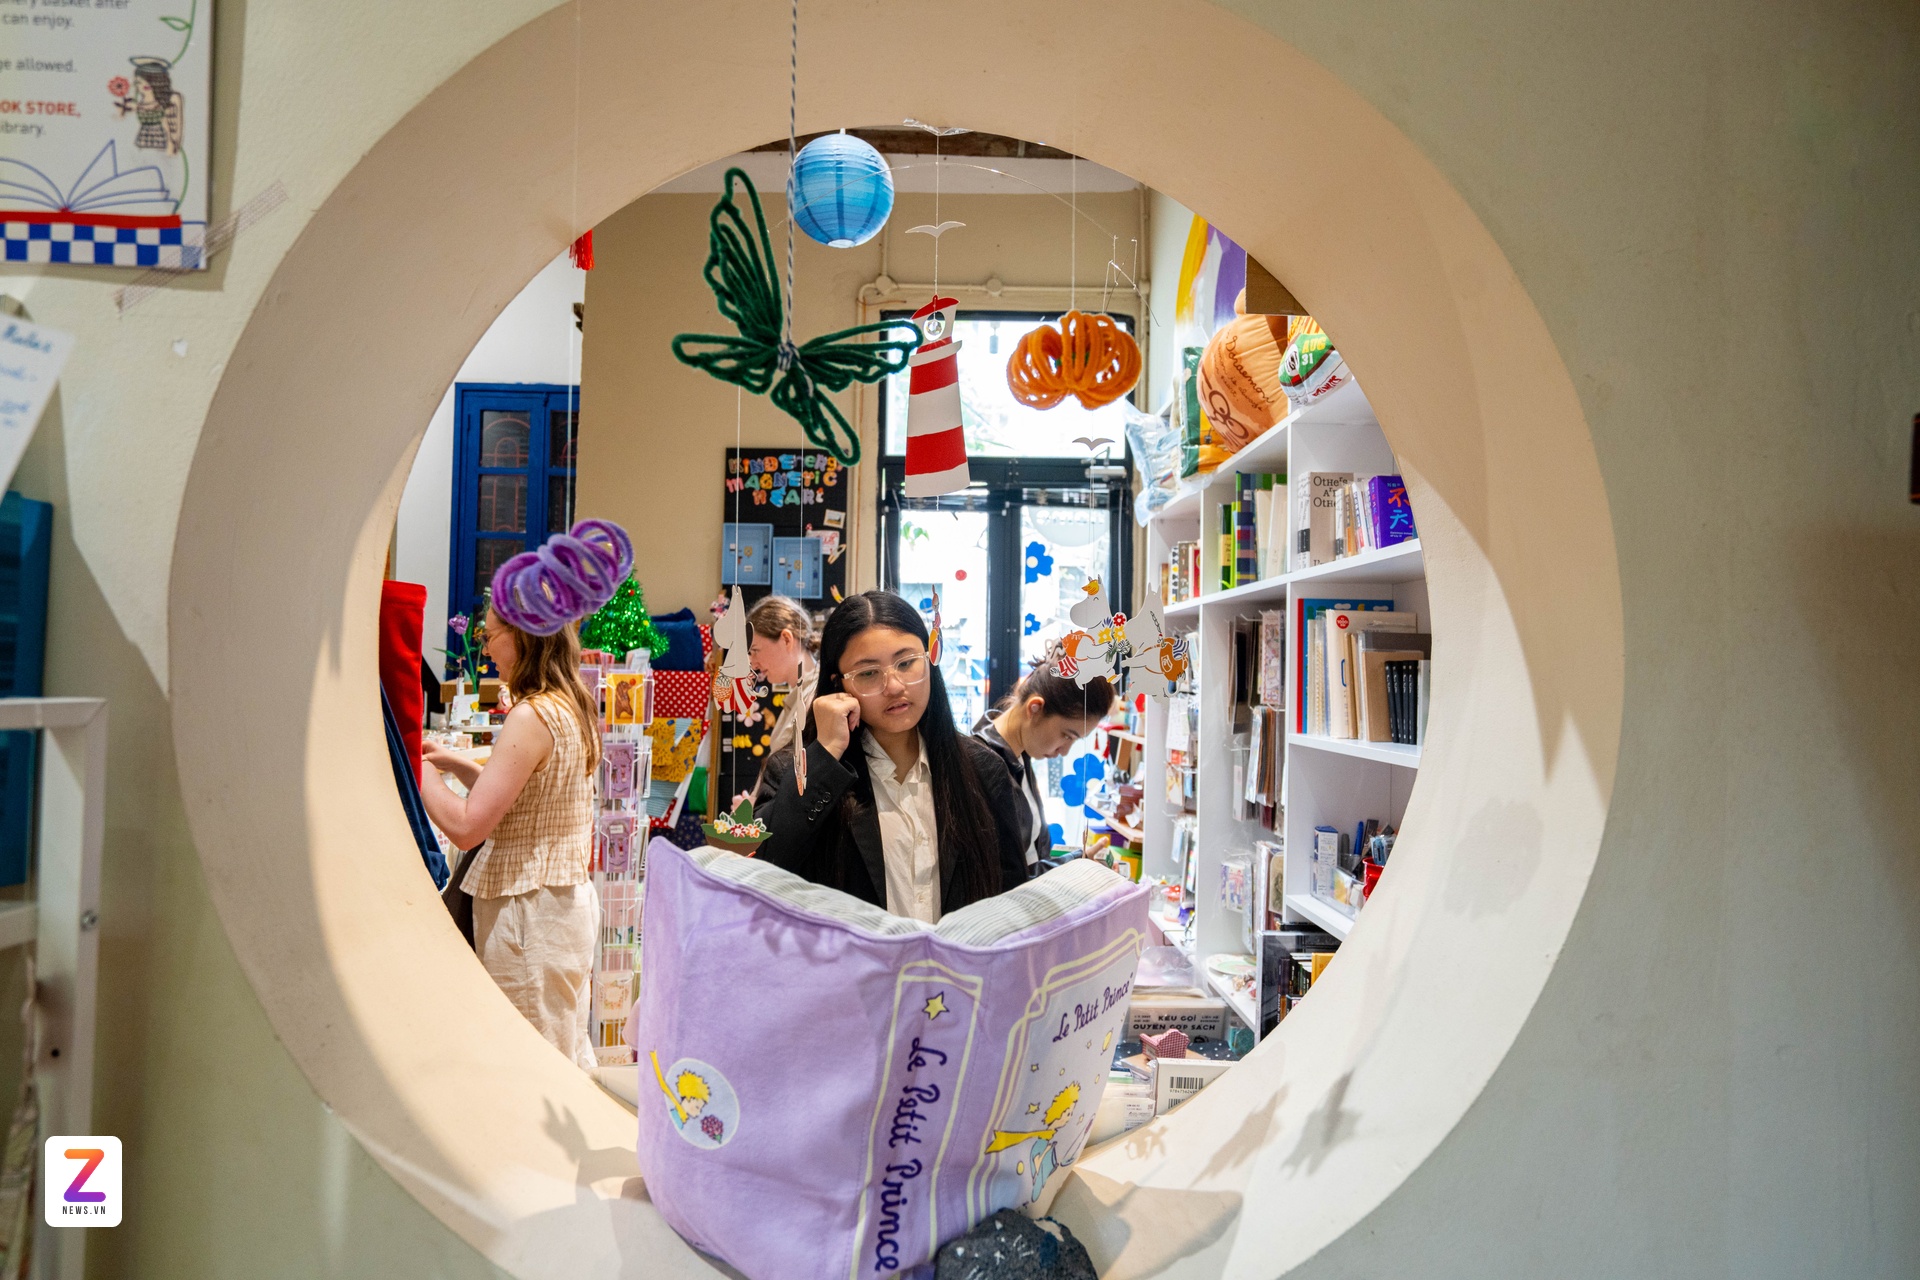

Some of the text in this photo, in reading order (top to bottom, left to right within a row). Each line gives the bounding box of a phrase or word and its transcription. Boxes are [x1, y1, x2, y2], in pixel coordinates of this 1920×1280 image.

[3, 14, 29, 25] can
[16, 58, 78, 73] allowed.
[26, 101, 82, 118] STORE,
[1302, 353, 1314, 366] 31
[1052, 980, 1130, 1043] Le Petit Prince
[874, 1037, 948, 1272] Le Petit Prince
